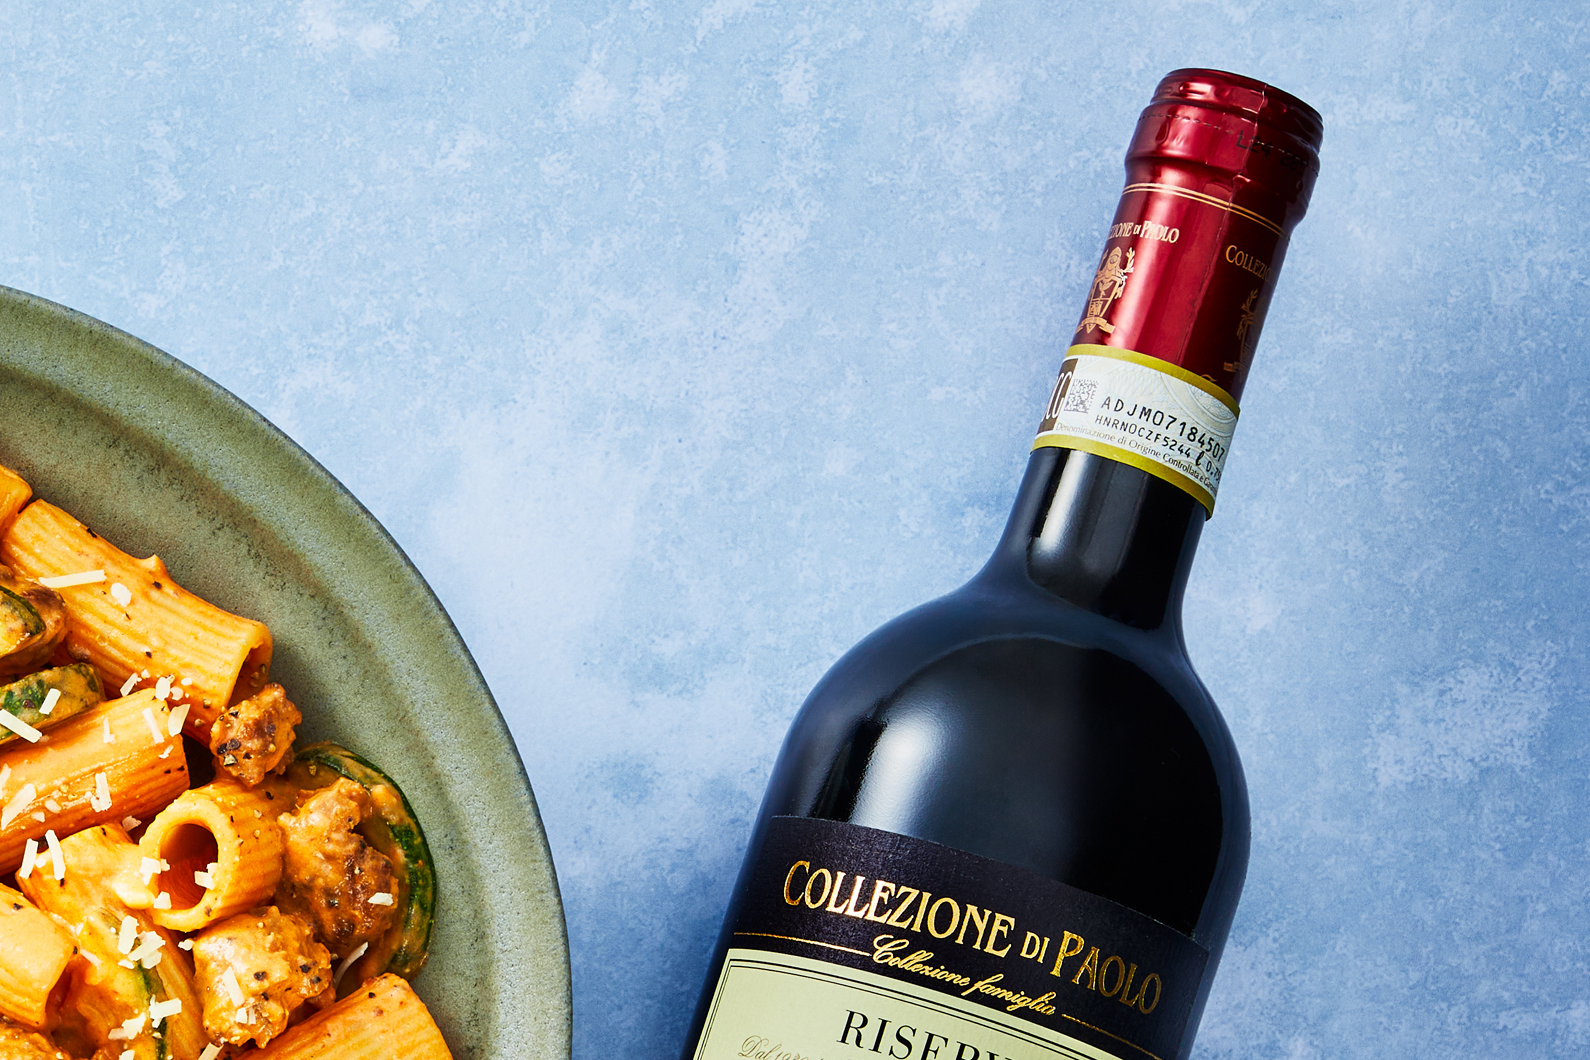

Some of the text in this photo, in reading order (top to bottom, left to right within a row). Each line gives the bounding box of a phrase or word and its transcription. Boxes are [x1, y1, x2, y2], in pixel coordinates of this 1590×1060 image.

[1139, 220, 1180, 243] PAOLO
[1055, 422, 1116, 441] Denominazione
[1117, 433, 1127, 445] di
[1128, 439, 1161, 458] Origine
[1162, 452, 1199, 479] Controllata
[783, 860, 1162, 1015] COLLEZIONE DI PAOLO
[872, 935, 1056, 1016] Collezione famiglia
[738, 1035, 782, 1060] Dal
